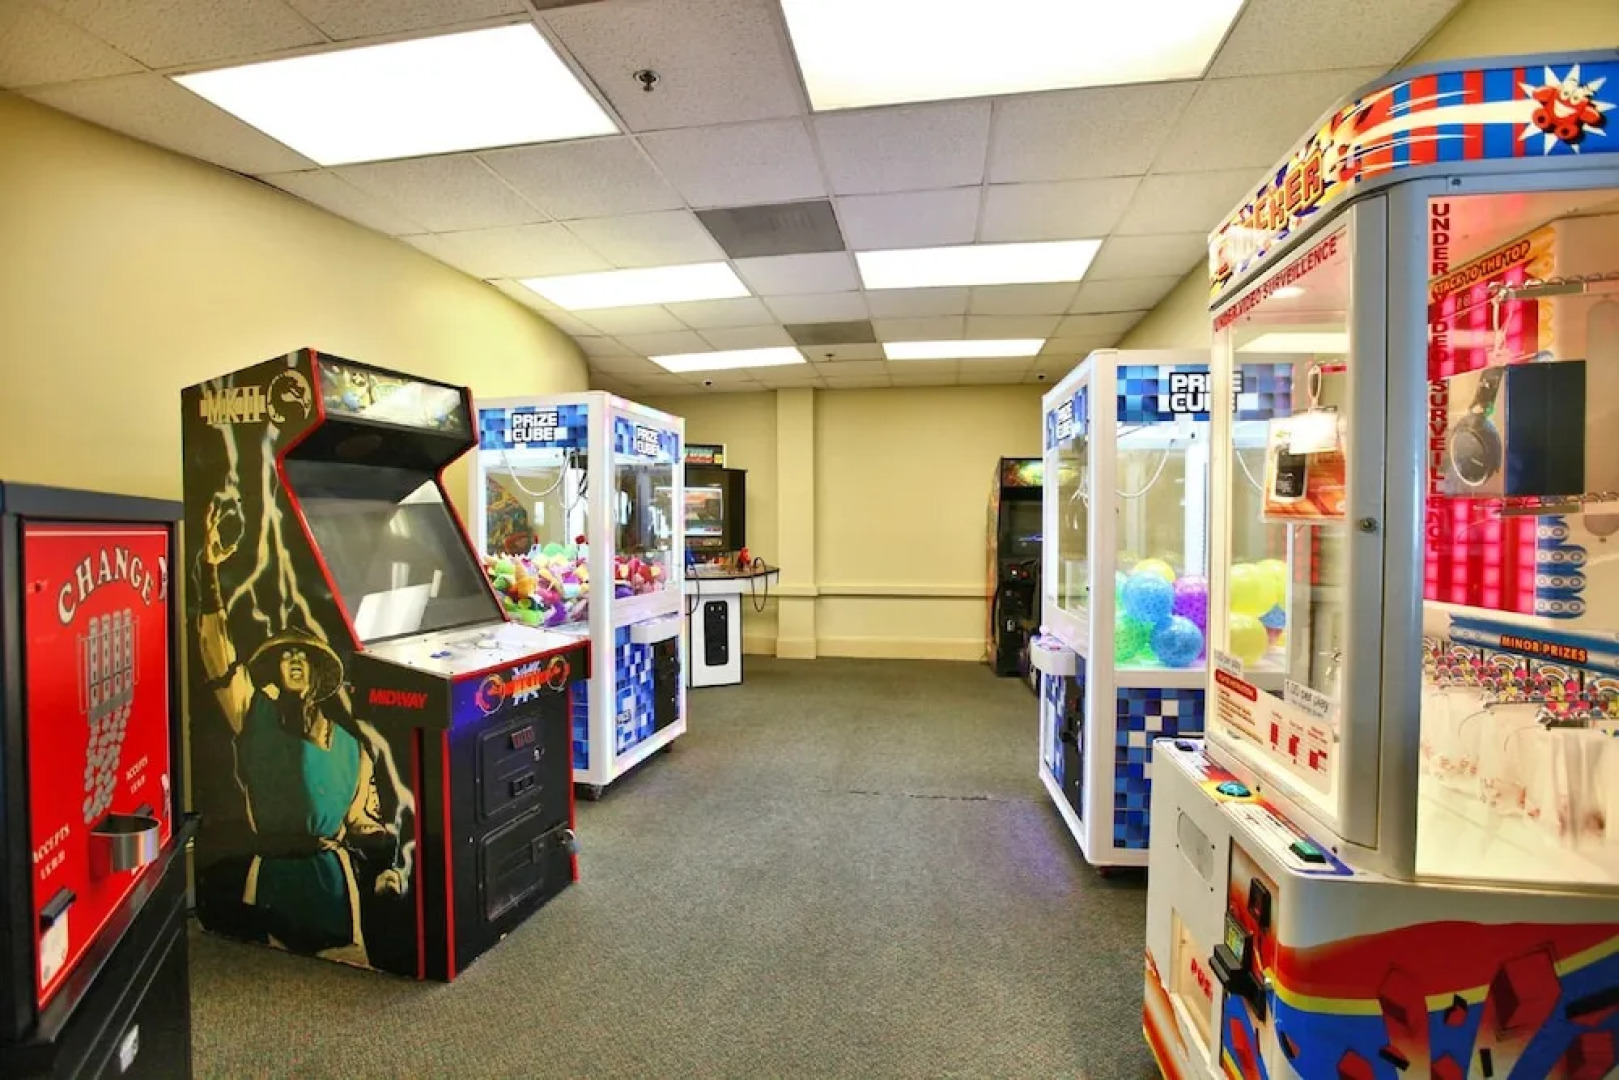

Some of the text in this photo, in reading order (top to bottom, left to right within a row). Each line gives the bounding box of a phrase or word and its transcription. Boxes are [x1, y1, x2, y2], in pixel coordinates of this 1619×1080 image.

[1431, 203, 1449, 275] UNDER
[1463, 264, 1480, 286] TO
[1504, 240, 1530, 266] TOP
[1238, 286, 1261, 317] VIDEO
[1169, 372, 1244, 393] PRIE
[512, 413, 558, 427] PRIZE
[512, 427, 555, 442] CUBE
[58, 546, 154, 625] CHANGE
[1501, 635, 1587, 662] MINOR PRIZES
[369, 688, 428, 709] MIDWAY
